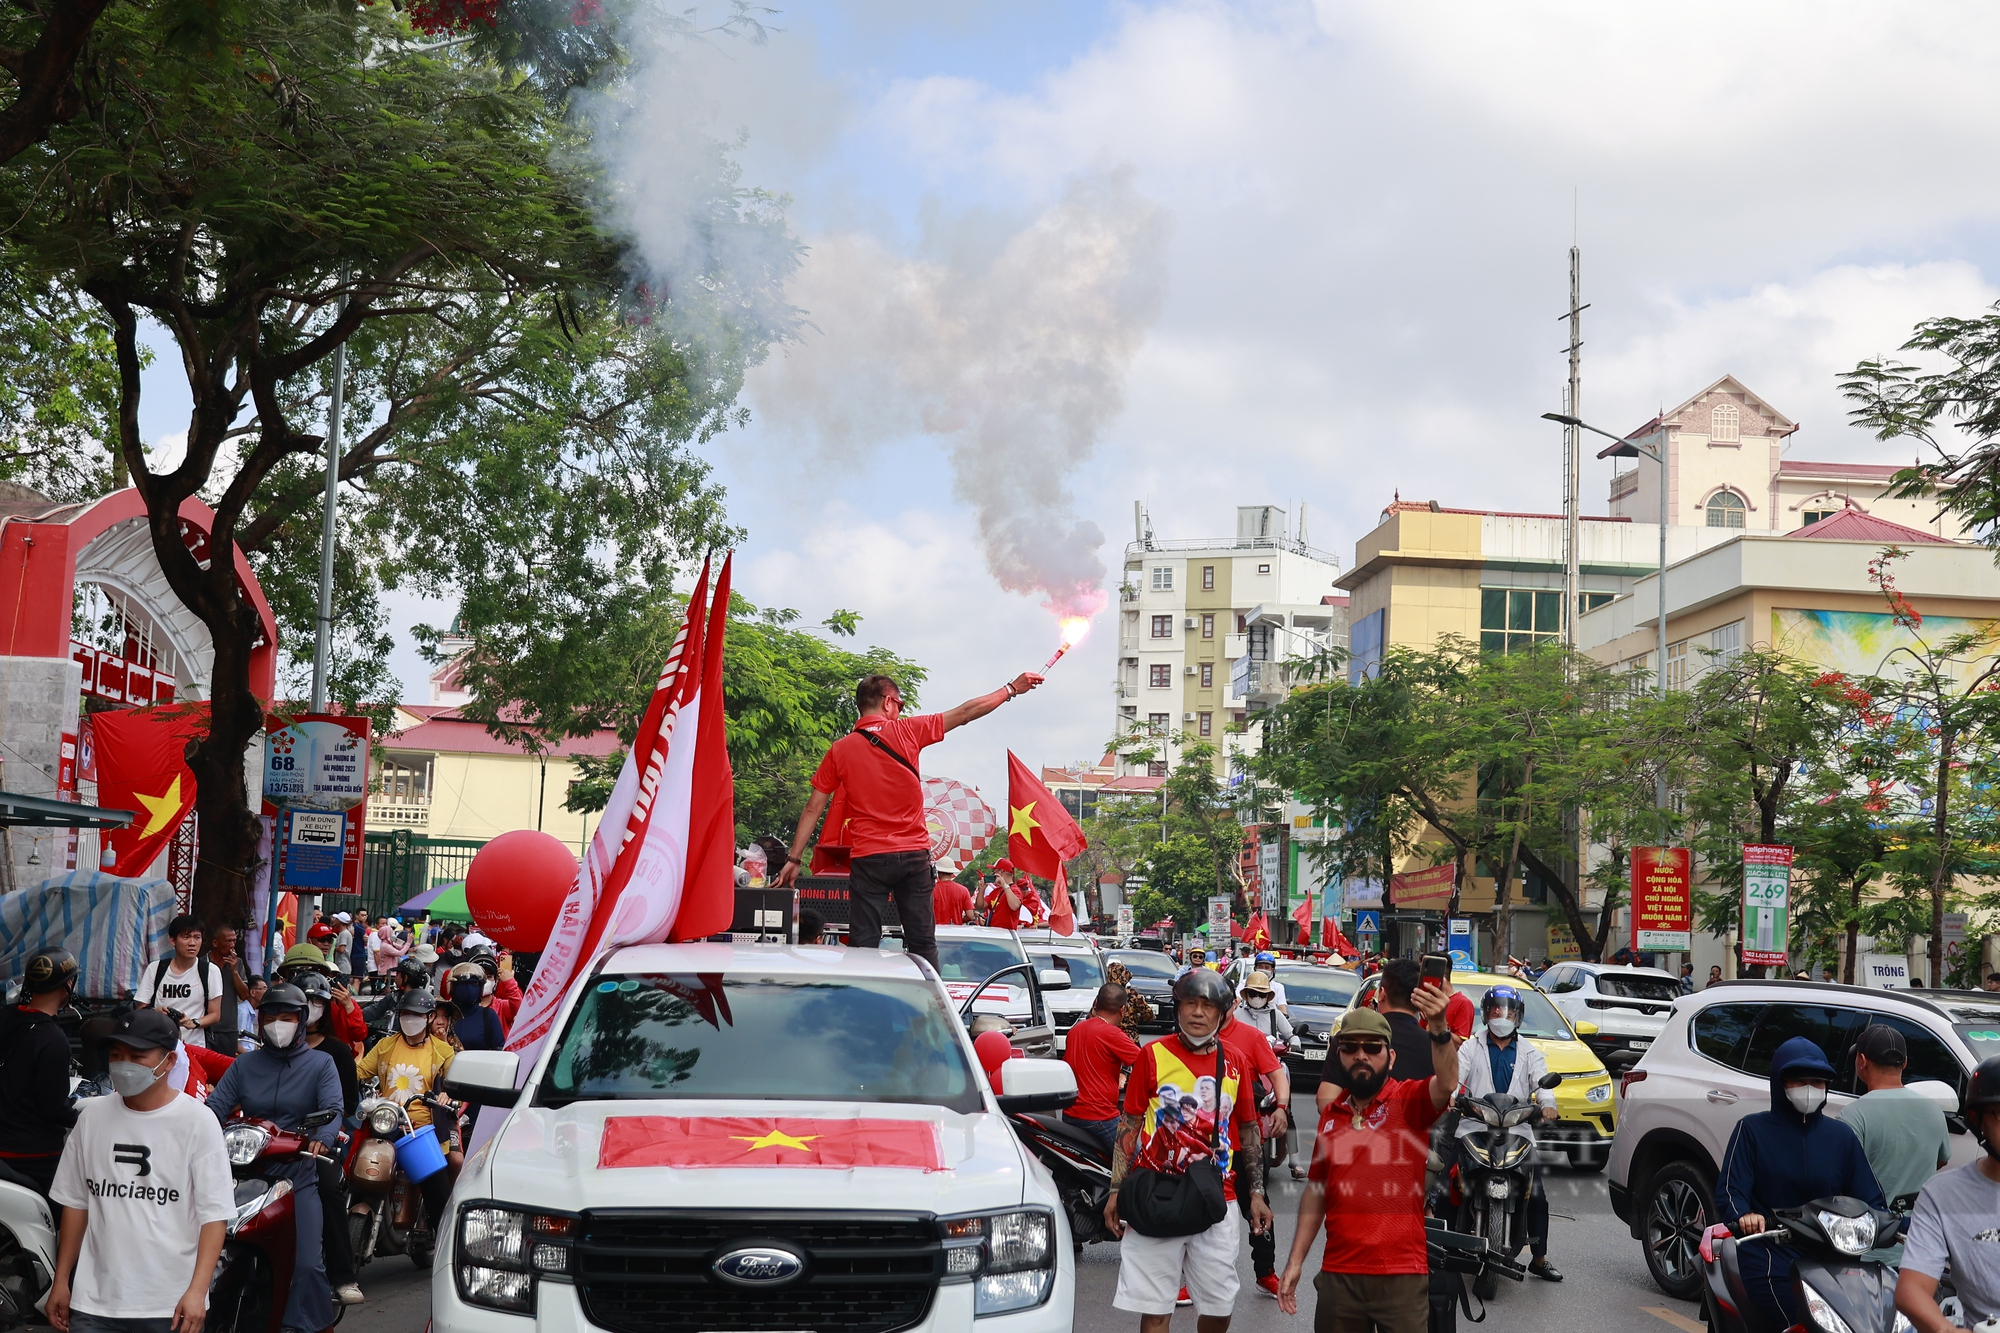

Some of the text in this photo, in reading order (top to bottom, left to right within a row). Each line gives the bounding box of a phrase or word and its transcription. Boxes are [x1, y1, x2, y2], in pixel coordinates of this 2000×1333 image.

[271, 756, 295, 771] 68
[269, 783, 289, 792] 13/5
[1654, 866, 1674, 874] NƯỚC
[1645, 875, 1683, 884] CỘNG HÒA
[800, 886, 826, 900] BÓNG
[827, 888, 841, 901] ĐÁ
[1652, 885, 1677, 894] XÃ HỘI
[1749, 882, 1785, 899] 2.69
[1644, 894, 1684, 902] CHỦ NGHĨA
[1647, 904, 1682, 912] VIỆT NAM
[559, 900, 590, 937] HẢI
[1641, 913, 1664, 921] MUÔN
[1665, 913, 1683, 921] NĂM
[503, 925, 516, 933] MỚI
[525, 942, 572, 1008] PHÒNG
[1872, 963, 1905, 977] TRÔNG
[162, 983, 192, 998] HKG
[86, 1178, 180, 1206] Balnciaege
[735, 1255, 784, 1277] Ford
